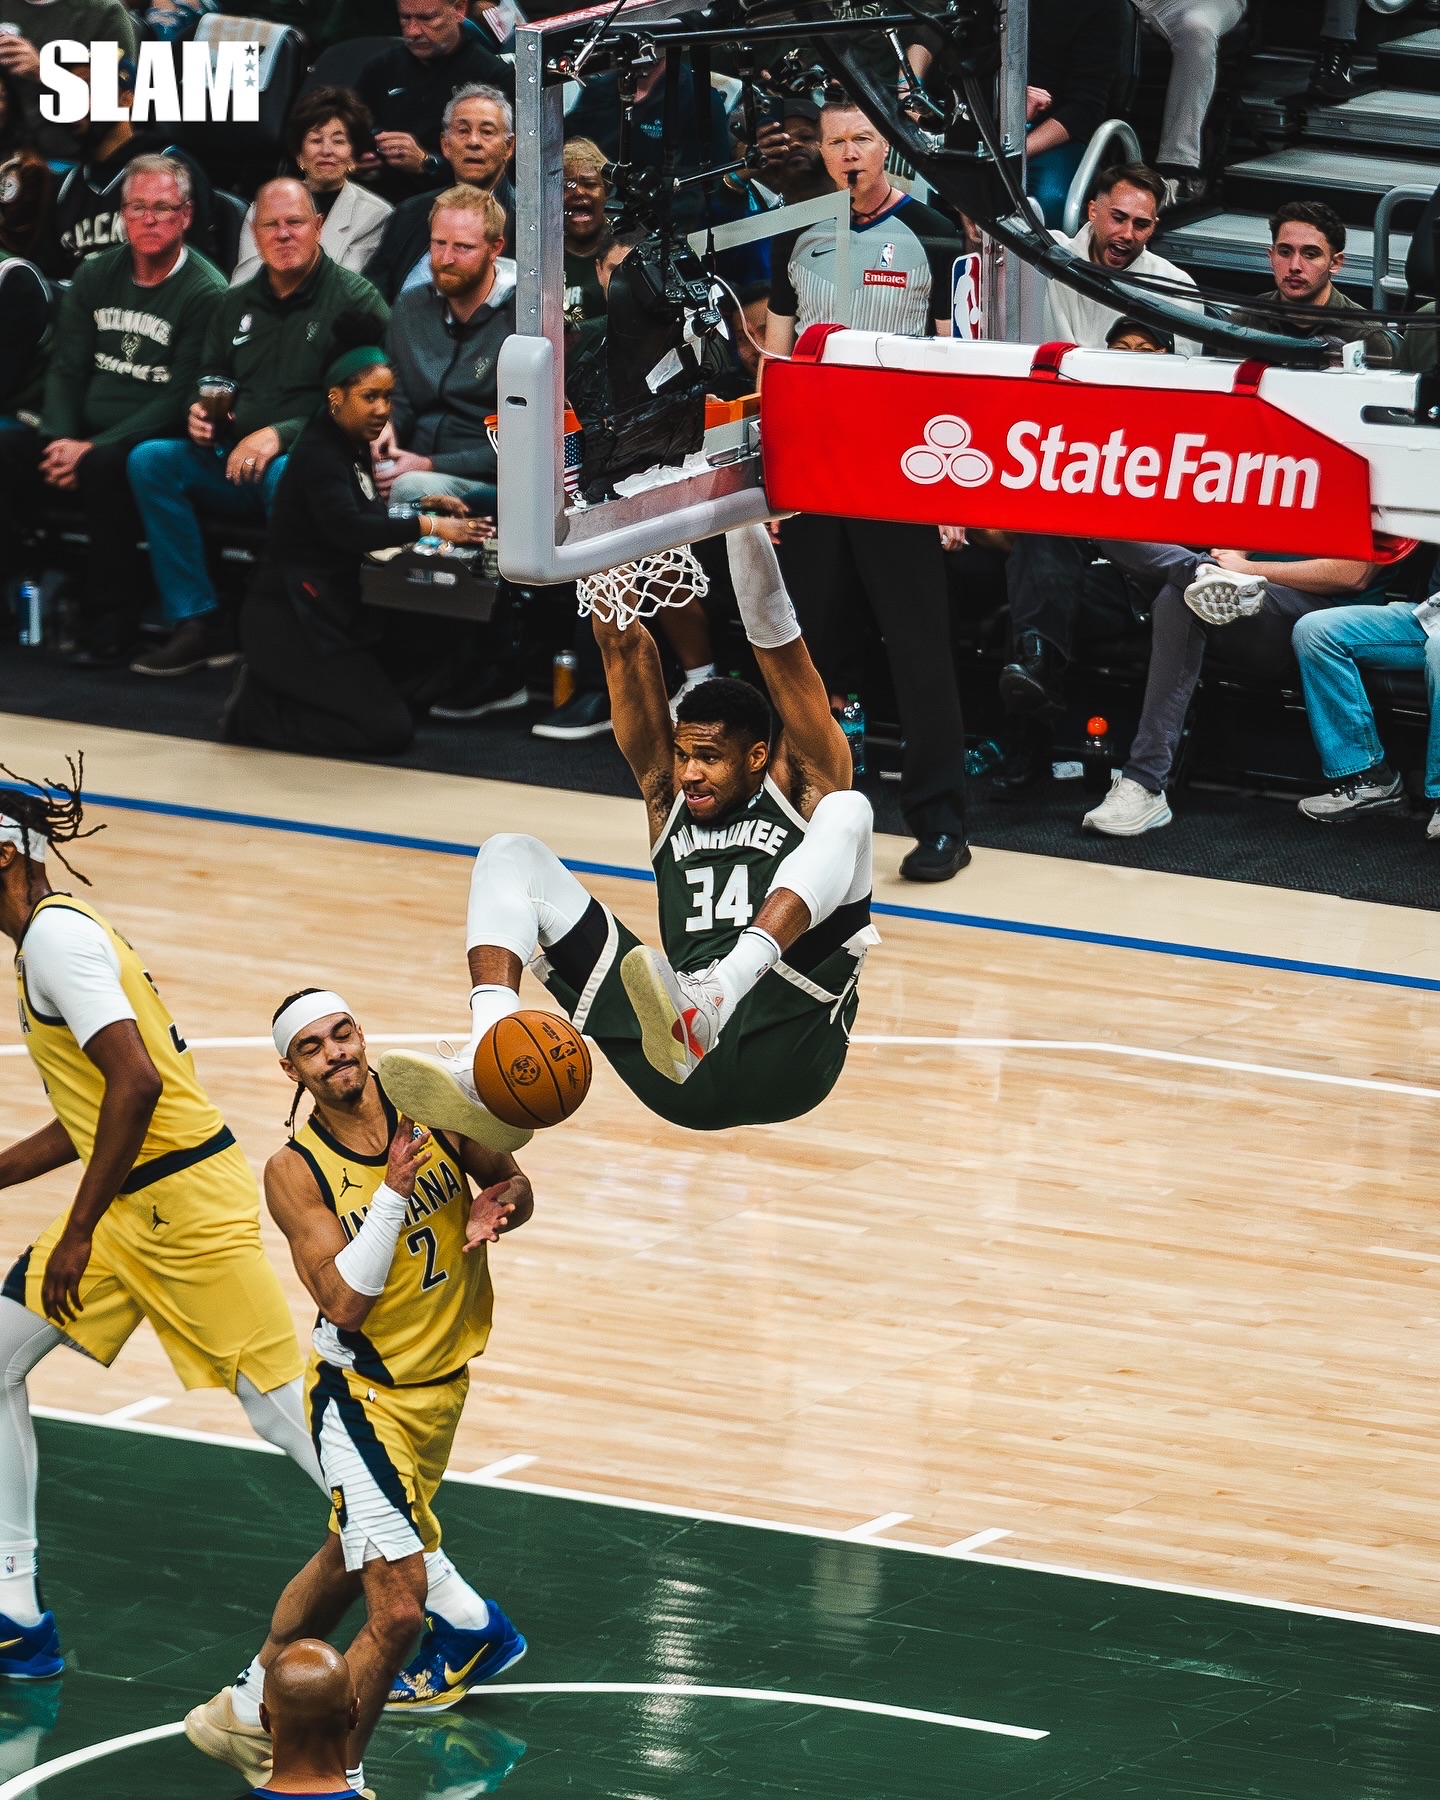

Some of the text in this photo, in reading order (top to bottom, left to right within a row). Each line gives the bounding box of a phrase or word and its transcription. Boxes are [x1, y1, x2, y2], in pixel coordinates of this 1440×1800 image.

[864, 272, 906, 285] Emirates
[670, 819, 789, 863] MILWAUKEE
[685, 864, 754, 932] 34
[406, 1226, 450, 1293] 2
